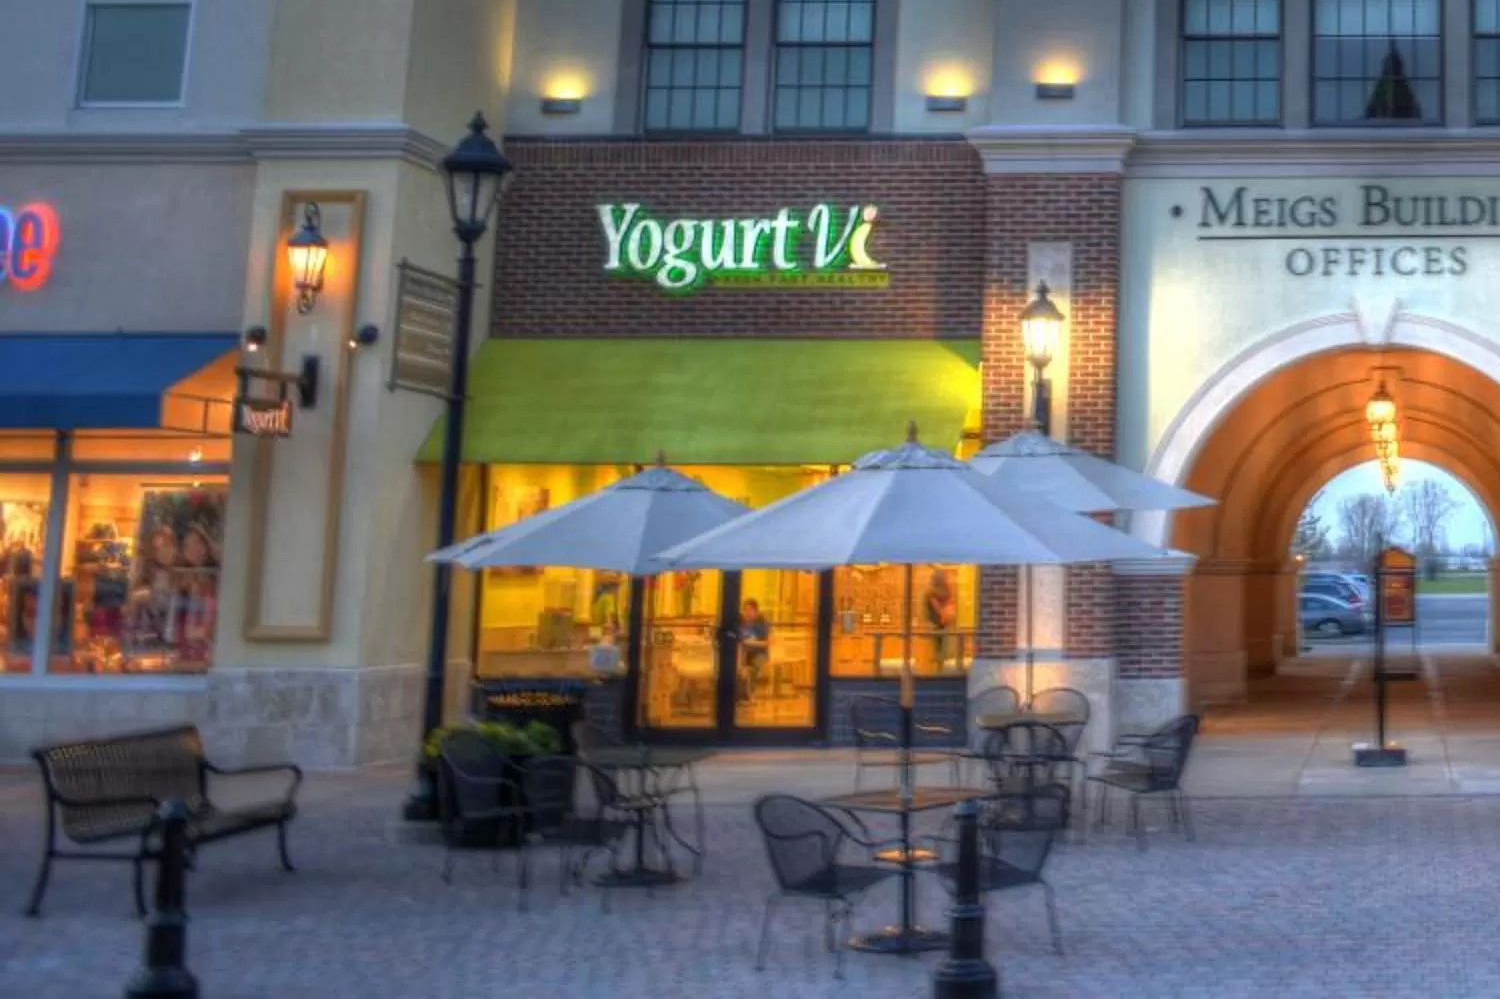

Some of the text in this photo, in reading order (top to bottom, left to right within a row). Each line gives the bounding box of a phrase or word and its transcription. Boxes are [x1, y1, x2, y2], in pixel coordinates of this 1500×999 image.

[1198, 186, 1338, 229] MEIGS
[597, 202, 800, 288] Yogurt
[1285, 246, 1469, 278] OFFICES
